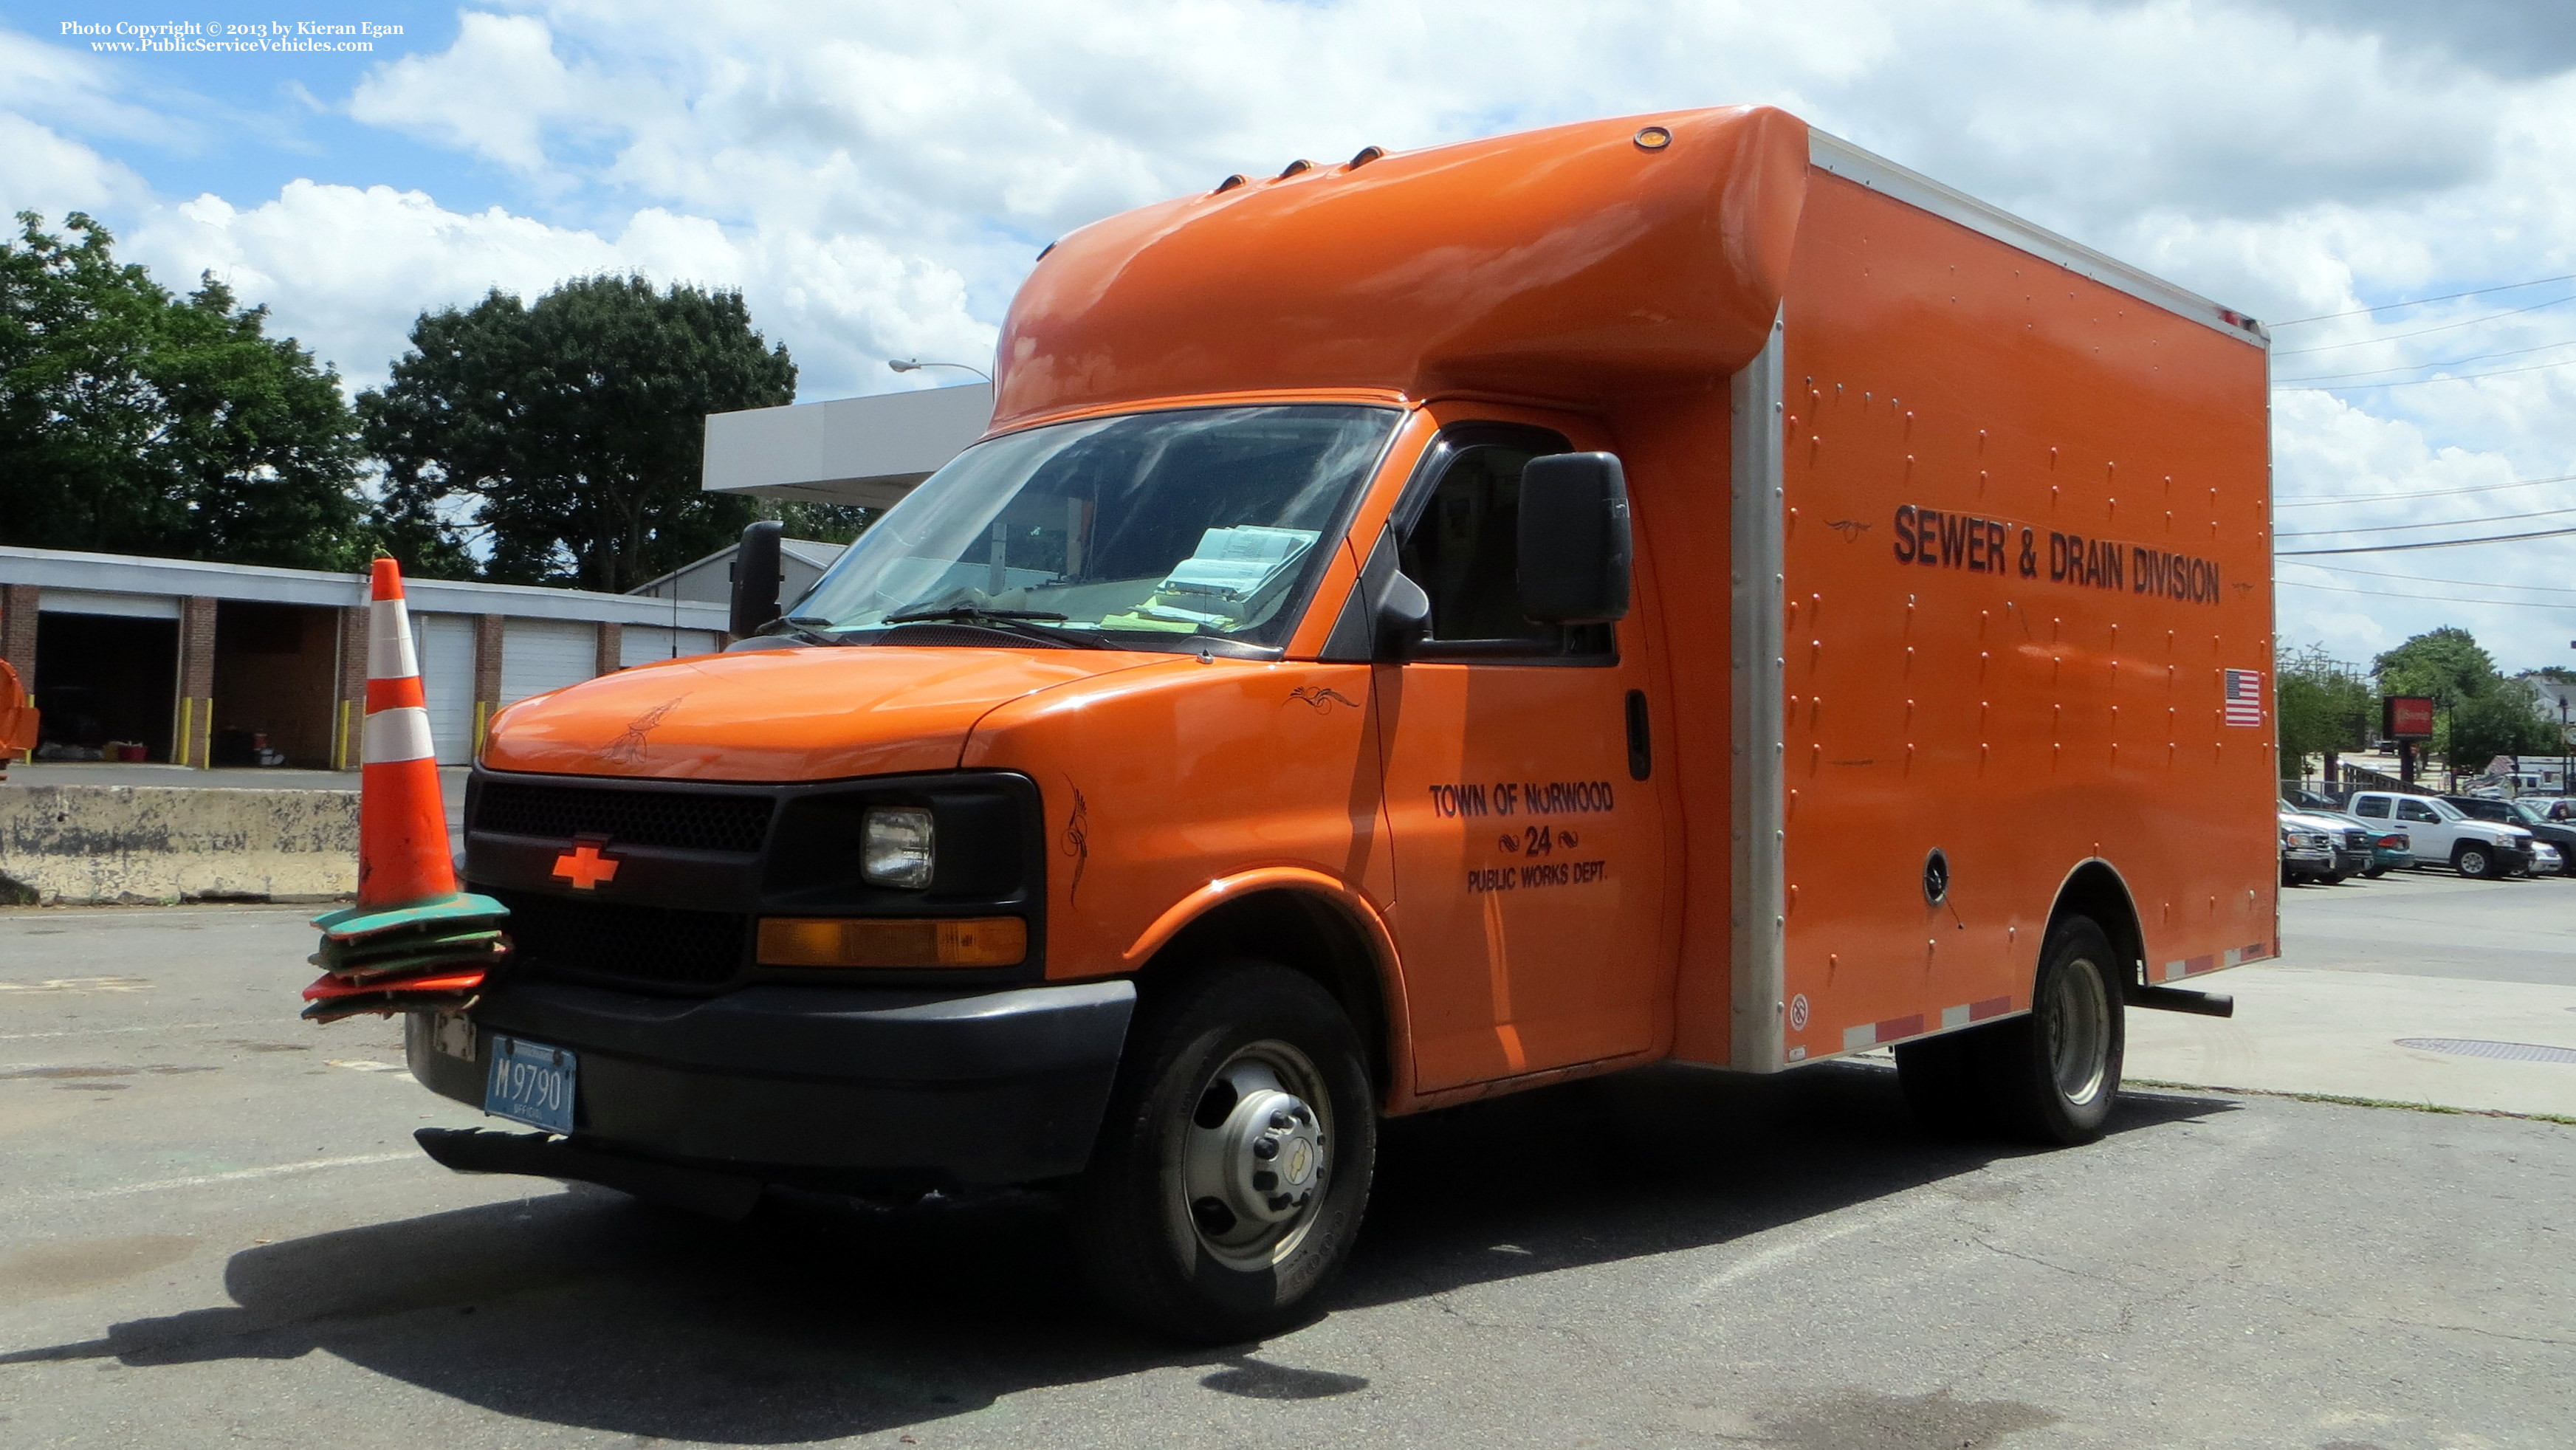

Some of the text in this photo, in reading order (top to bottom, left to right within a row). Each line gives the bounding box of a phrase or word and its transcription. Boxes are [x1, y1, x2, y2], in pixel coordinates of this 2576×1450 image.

[1893, 504, 2220, 604] SEWER & DRAIN DIVISION
[1429, 781, 1614, 818] TOWN OF NORWOOD
[1525, 825, 1552, 858] 24
[1468, 860, 1608, 893] PUBLIC WORKS DEPT.
